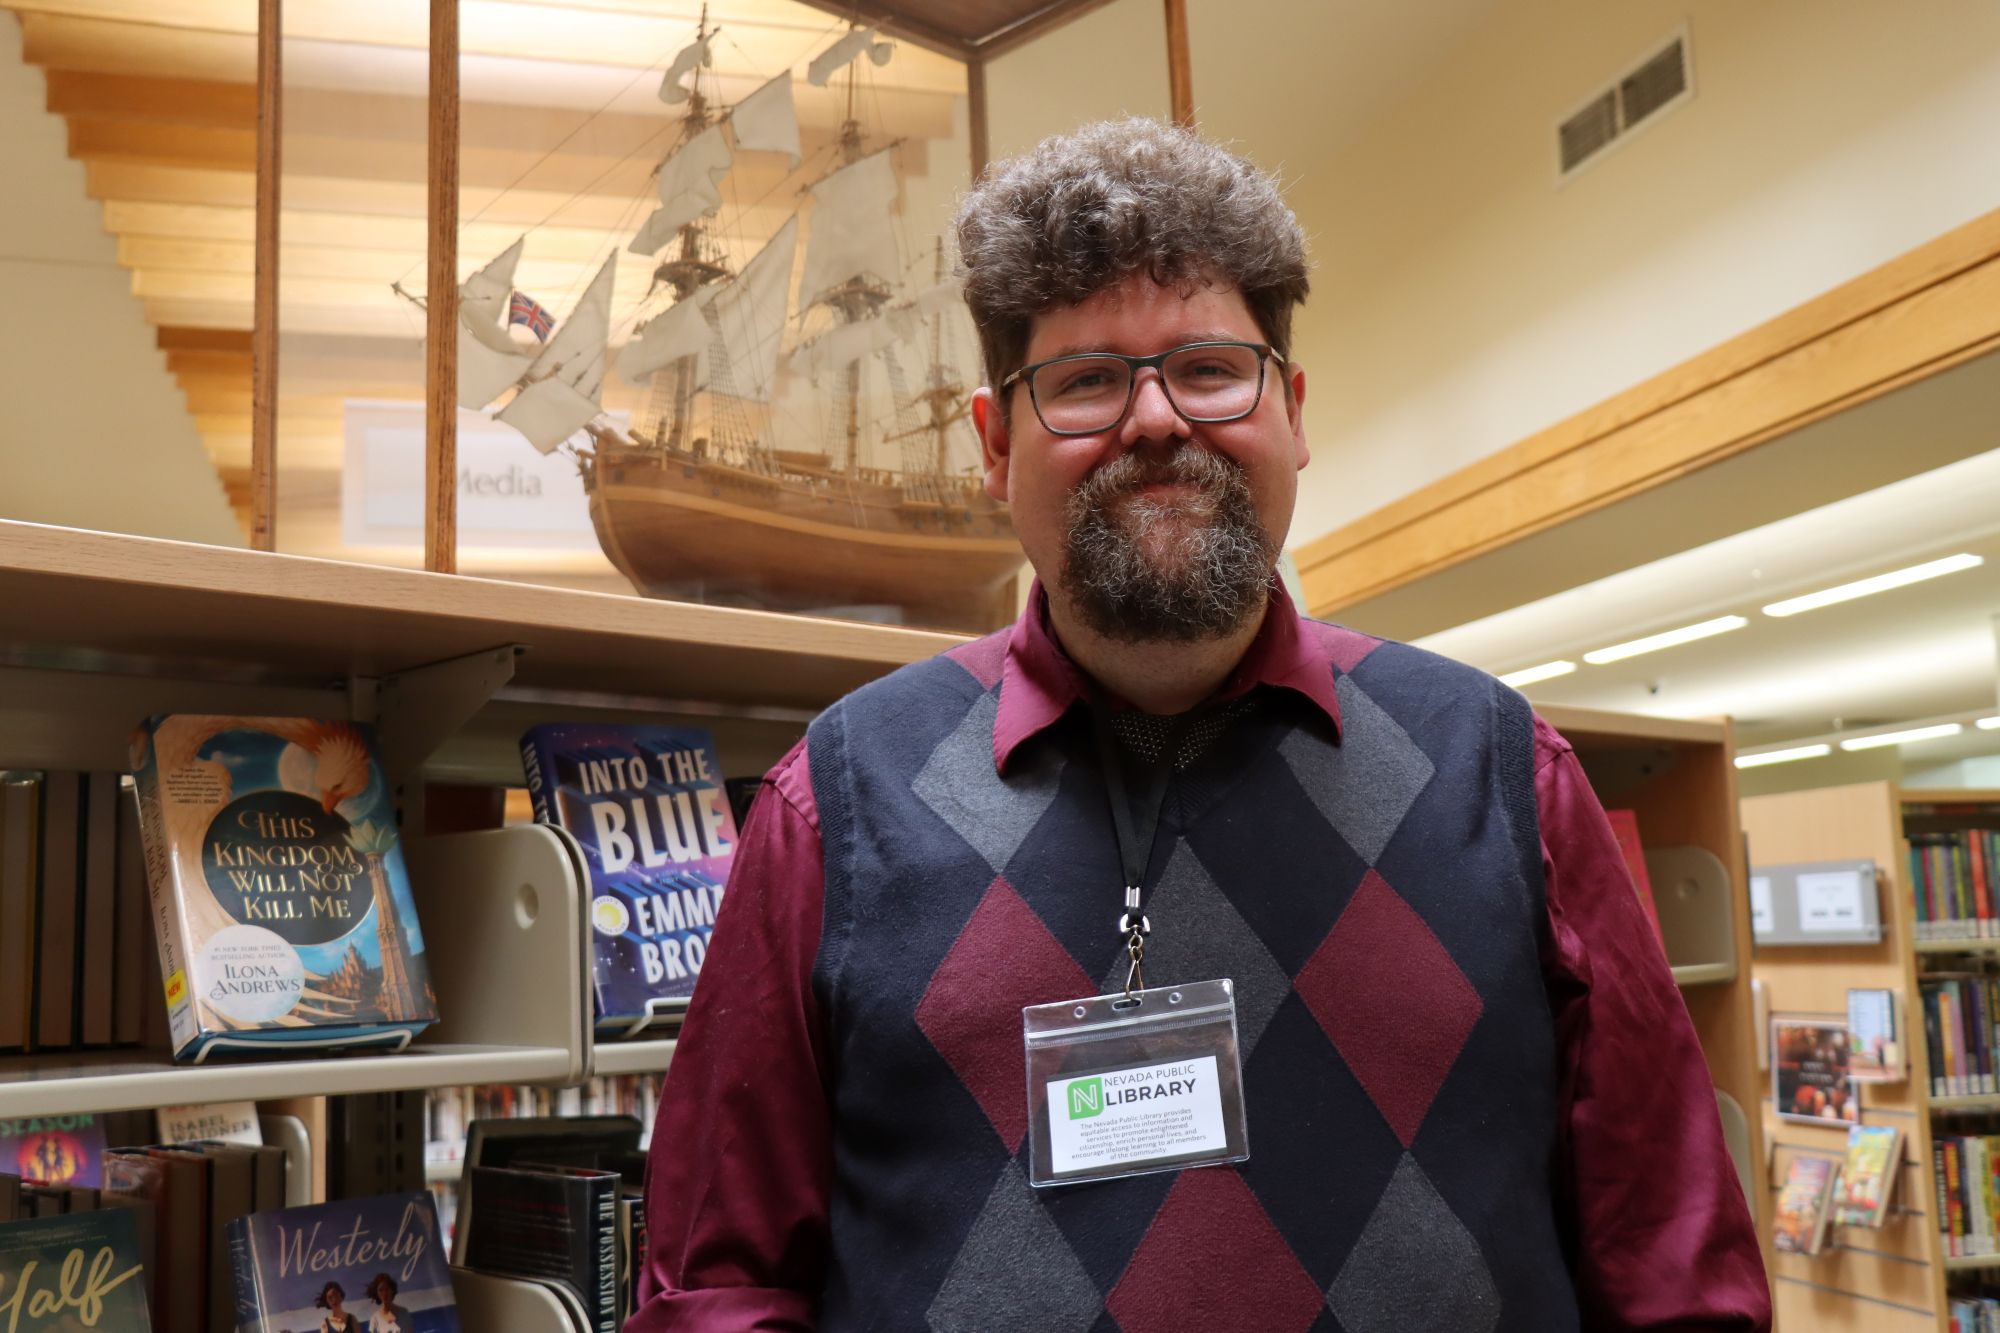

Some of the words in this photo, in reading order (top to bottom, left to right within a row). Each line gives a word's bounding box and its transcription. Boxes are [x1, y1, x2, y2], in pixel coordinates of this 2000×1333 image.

[523, 741, 542, 793] INTO
[579, 756, 649, 795] INTO
[657, 748, 711, 785] THE
[238, 810, 316, 838] THIS
[591, 787, 732, 875] BLUE
[214, 842, 362, 874] KINGDOM
[228, 869, 295, 893] WILL
[299, 869, 355, 892] NOT
[244, 896, 302, 919] KILL
[309, 895, 351, 918] ME
[640, 931, 712, 984] BRO
[225, 964, 279, 979] ILONA
[210, 980, 300, 1000] ANDREWS
[1104, 1071, 1153, 1087] NEVADA
[1156, 1064, 1196, 1079] PUBLIC
[1105, 1078, 1196, 1106] LIBRARY
[169, 1114, 225, 1132] ISABEL
[1080, 1127, 1110, 1137] equitable
[1111, 1123, 1133, 1132] access
[1141, 1117, 1179, 1127] information
[1094, 1118, 1118, 1127] Nevada
[1119, 1115, 1138, 1124] Public
[1140, 1112, 1162, 1122] Library
[1163, 1108, 1192, 1118] provides
[1086, 1134, 1112, 1143] services
[1121, 1128, 1148, 1138] promote
[1150, 1122, 1189, 1134] enlightened
[1116, 1136, 1137, 1145] enrich
[1137, 1132, 1165, 1143] personal
[1071, 1149, 1104, 1160] encourage
[1105, 1144, 1130, 1154] lifelong
[1130, 1140, 1157, 1150] learning
[1166, 1137, 1175, 1145] all
[1175, 1134, 1207, 1143] members
[1118, 1151, 1130, 1159] the
[599, 1190, 615, 1220] THE
[277, 1202, 426, 1282] Westerly
[599, 1226, 615, 1314] POSSESSION
